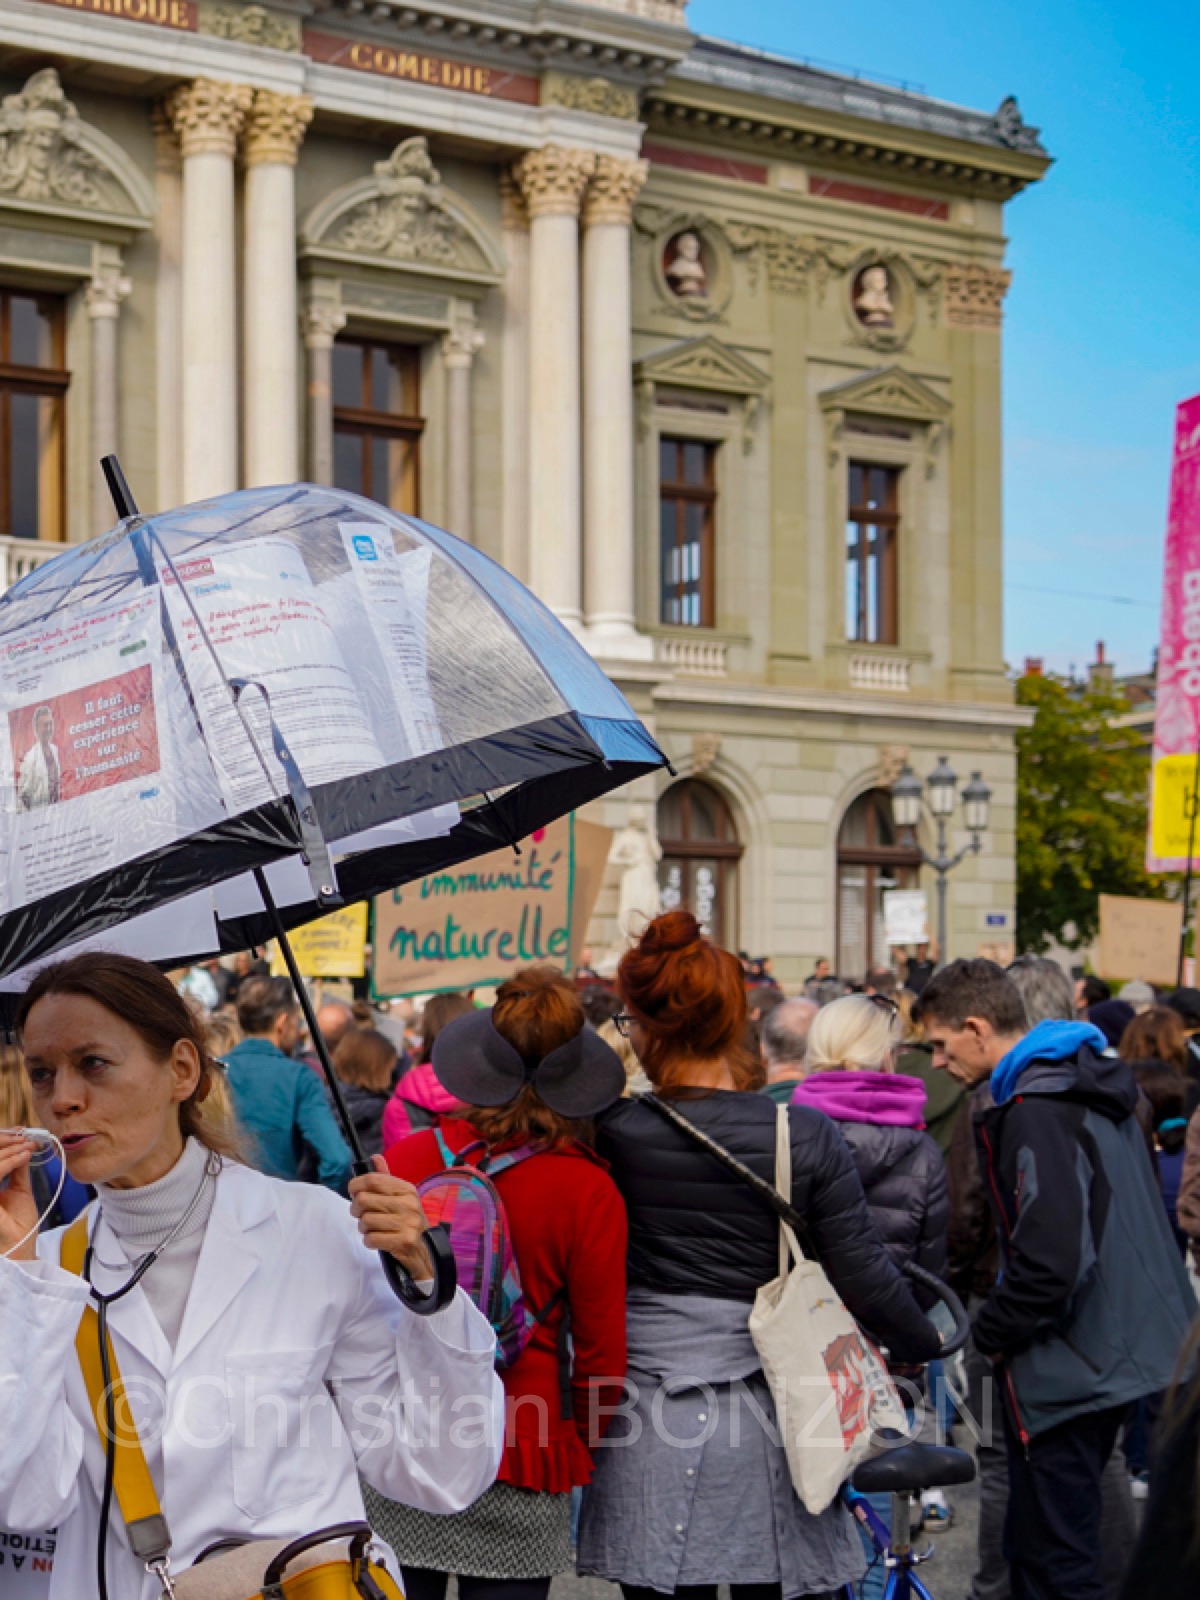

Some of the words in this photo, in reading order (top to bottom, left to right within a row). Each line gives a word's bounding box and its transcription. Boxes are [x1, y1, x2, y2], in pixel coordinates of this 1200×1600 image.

[68, 714, 107, 735] cesser
[108, 702, 142, 721] cette
[84, 701, 95, 715] Il
[97, 693, 124, 711] faut
[73, 720, 140, 749] expérience
[97, 742, 118, 757] sur
[75, 750, 142, 780] l'humanité
[390, 903, 571, 962] naturelle
